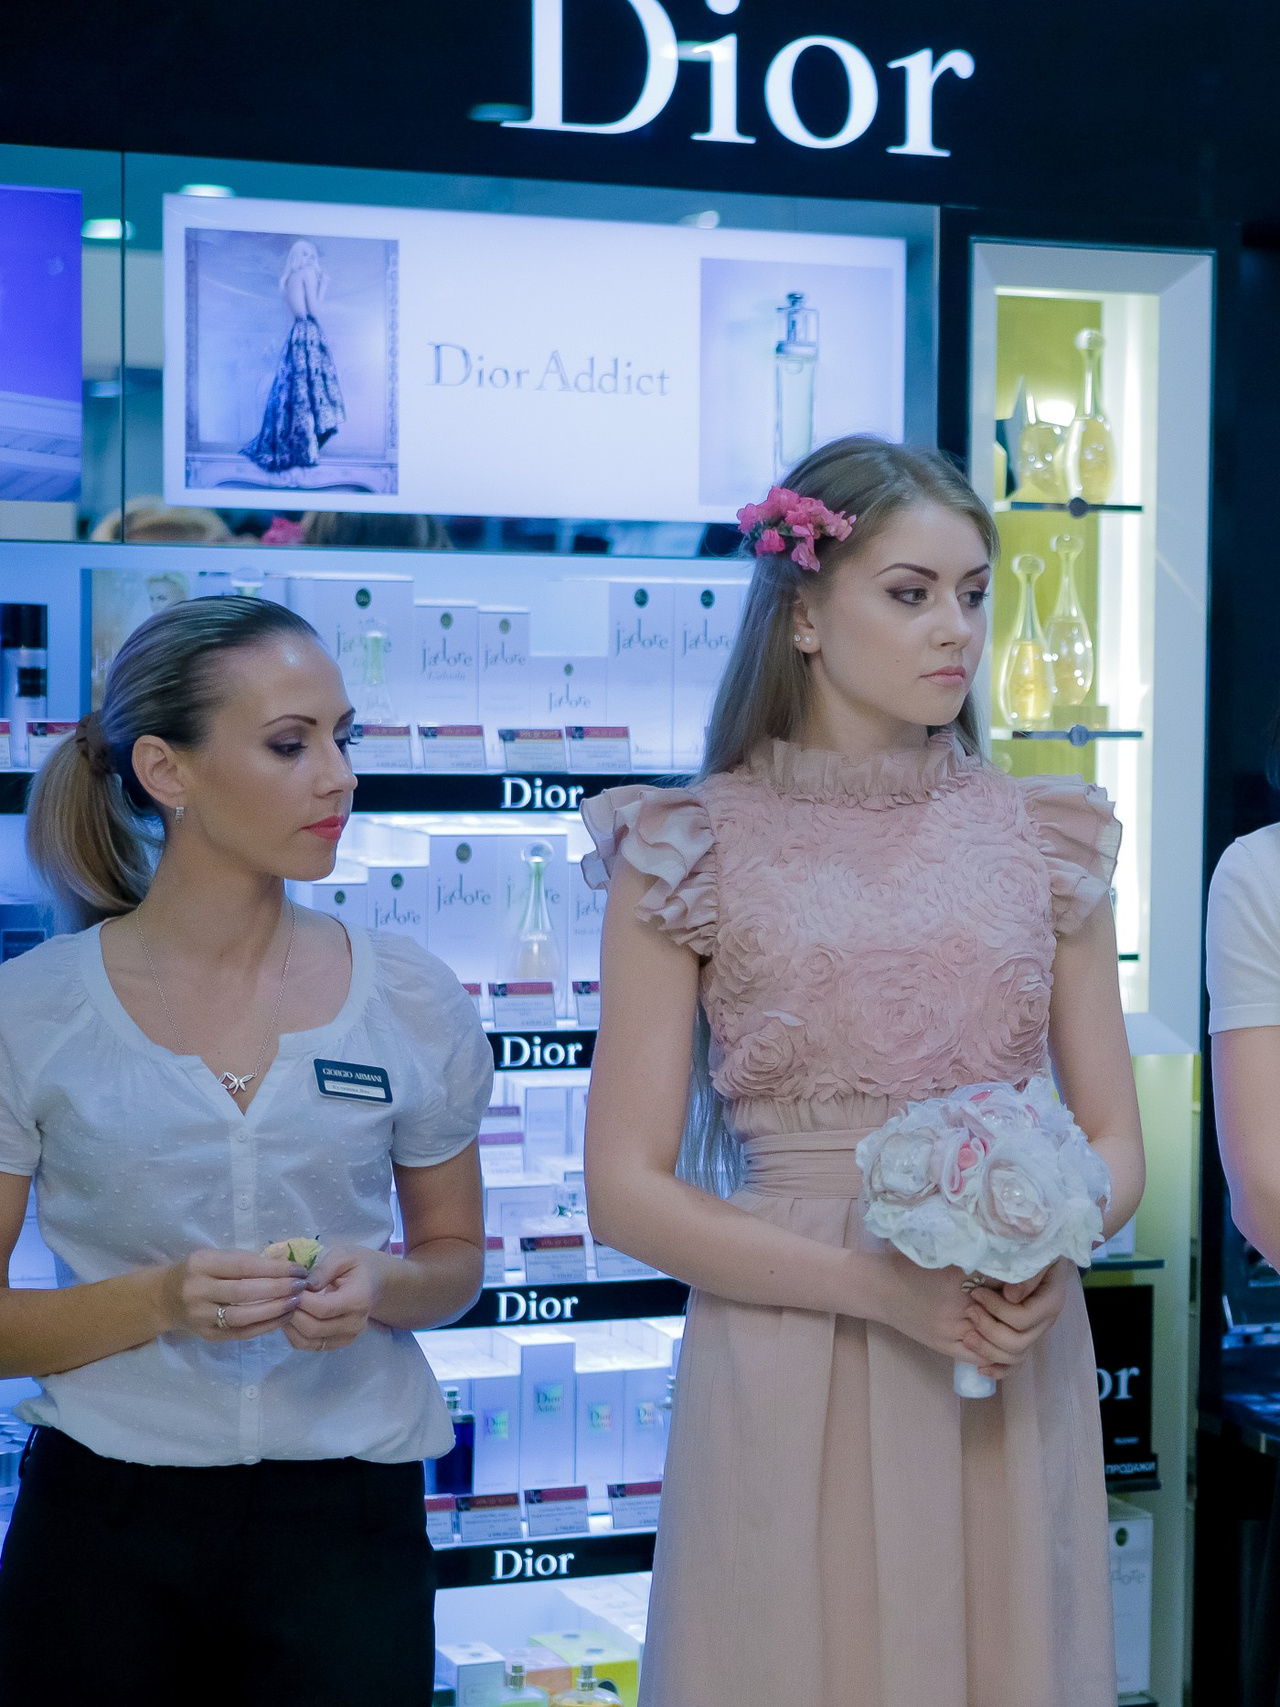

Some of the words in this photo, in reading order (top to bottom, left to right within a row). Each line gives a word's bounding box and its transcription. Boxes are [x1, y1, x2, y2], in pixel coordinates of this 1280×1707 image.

[500, 0, 975, 157] Dior
[425, 341, 530, 391] Dior
[535, 350, 670, 396] Addict
[501, 777, 584, 808] Dior
[500, 1036, 583, 1067] Dior
[322, 1068, 353, 1079] GIORGIO
[355, 1073, 382, 1082] ARMANI
[497, 1291, 579, 1323] Dior
[491, 1548, 575, 1580] Dior
